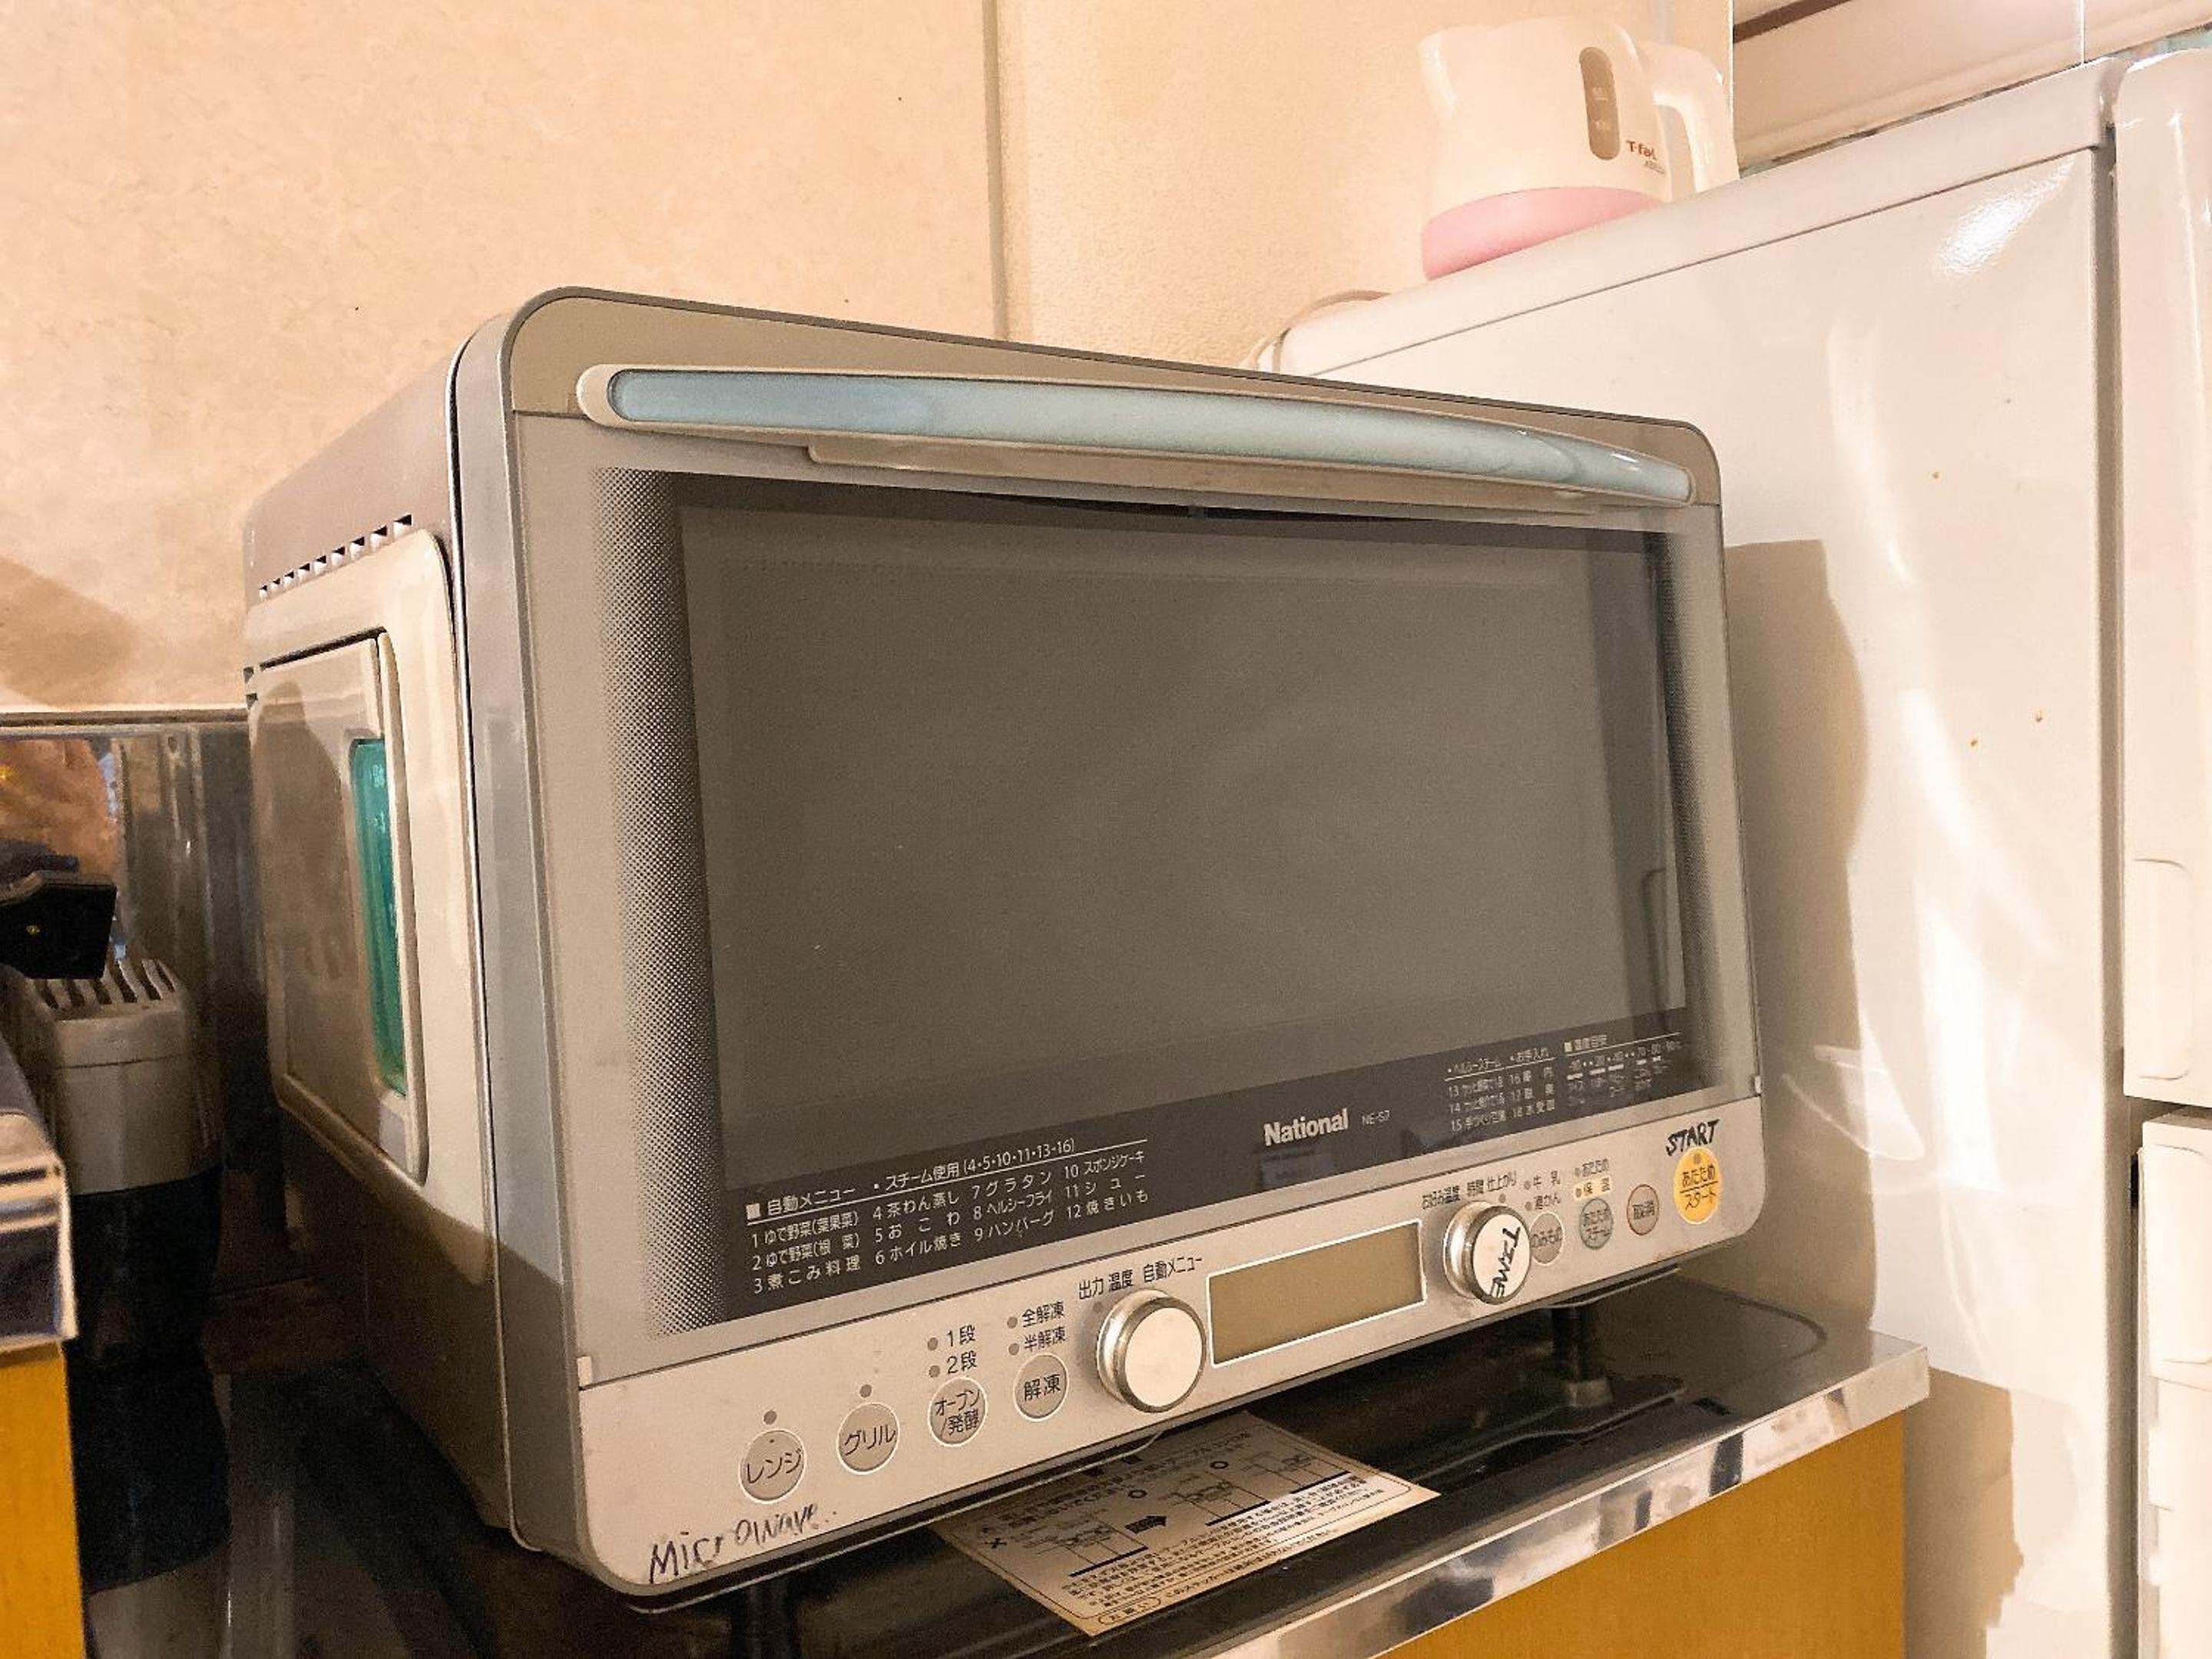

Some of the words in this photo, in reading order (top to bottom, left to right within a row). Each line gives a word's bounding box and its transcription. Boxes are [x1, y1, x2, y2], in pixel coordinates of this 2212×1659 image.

[1263, 1108, 1349, 1147] National
[1665, 1119, 1720, 1157] START
[972, 1184, 980, 1199] 7
[986, 1171, 1051, 1197] グラタン
[1065, 1164, 1078, 1179] 10
[1682, 1164, 1716, 1187] あたため
[768, 1188, 856, 1216] 自動メニュー
[973, 1205, 982, 1220] 8
[987, 1190, 1053, 1215] ヘルシーフライ
[1065, 1184, 1079, 1198] 11
[1685, 1187, 1717, 1210] スタート
[873, 1206, 882, 1220] 4
[887, 1191, 959, 1218] 茶わん蒸し
[1066, 1204, 1081, 1219] 12
[875, 1227, 883, 1243] 5
[975, 1227, 983, 1242] 9
[988, 1209, 1055, 1232] ハンバーグ
[752, 1233, 759, 1248] 1
[875, 1250, 884, 1266] 6
[889, 1232, 962, 1262] ホイル焼き
[753, 1255, 762, 1270] 2
[754, 1278, 763, 1294] 3
[1078, 1277, 1104, 1300] 出力
[1108, 1270, 1134, 1293] 温度
[1143, 1257, 1203, 1283] 自動メニュー
[1022, 1301, 1065, 1328] 全解凍
[1024, 1326, 1066, 1353] 半解凍
[1023, 1373, 1061, 1402] 解凍
[844, 1423, 896, 1456] グリル
[746, 1447, 802, 1485] レンジ
